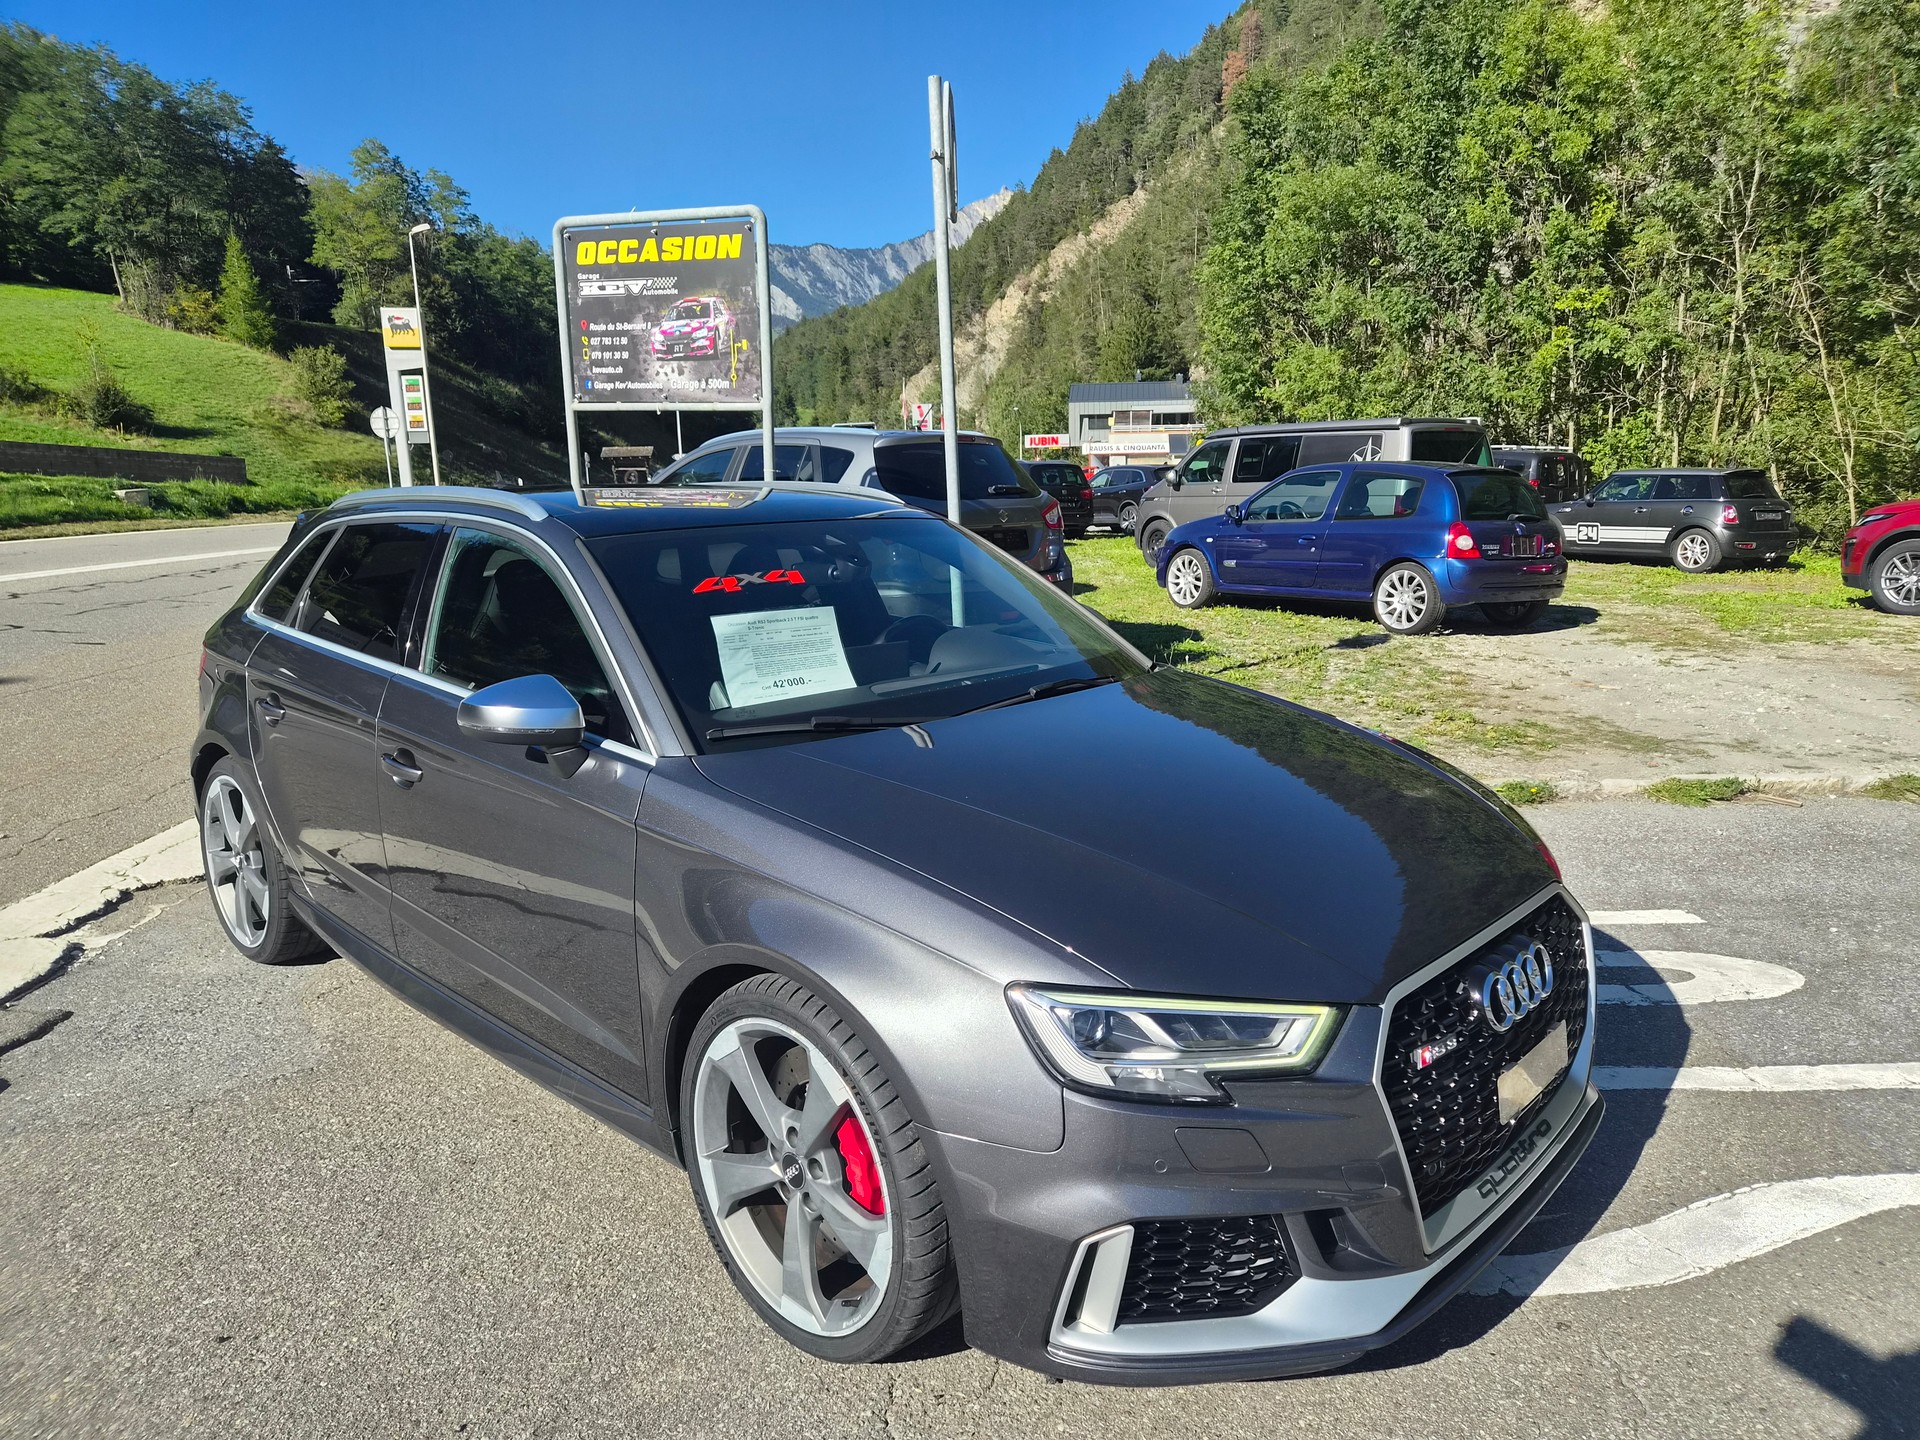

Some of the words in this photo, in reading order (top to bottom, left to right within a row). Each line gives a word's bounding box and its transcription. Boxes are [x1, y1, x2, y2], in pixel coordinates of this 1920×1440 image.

[576, 233, 743, 266] OCCASION
[577, 273, 600, 281] Garage
[589, 322, 606, 331] Route
[607, 323, 615, 331] du
[615, 321, 647, 331] St-Bernard
[590, 336, 601, 345] 027
[601, 336, 612, 345] 783
[613, 336, 620, 345] 12
[620, 336, 628, 345] 50
[591, 351, 602, 360] 079
[602, 351, 613, 360] 101
[613, 351, 621, 360] 30
[621, 350, 629, 359] 50
[592, 365, 624, 374] kevauto.ch
[593, 381, 614, 391] Garage
[670, 379, 699, 391] Garage
[700, 378, 706, 389] à
[707, 378, 730, 389] 500m
[1028, 436, 1059, 446] JUBIN
[1578, 525, 1598, 541] 24
[772, 676, 812, 688] 42'000.-
[1476, 1118, 1552, 1199] quattro
